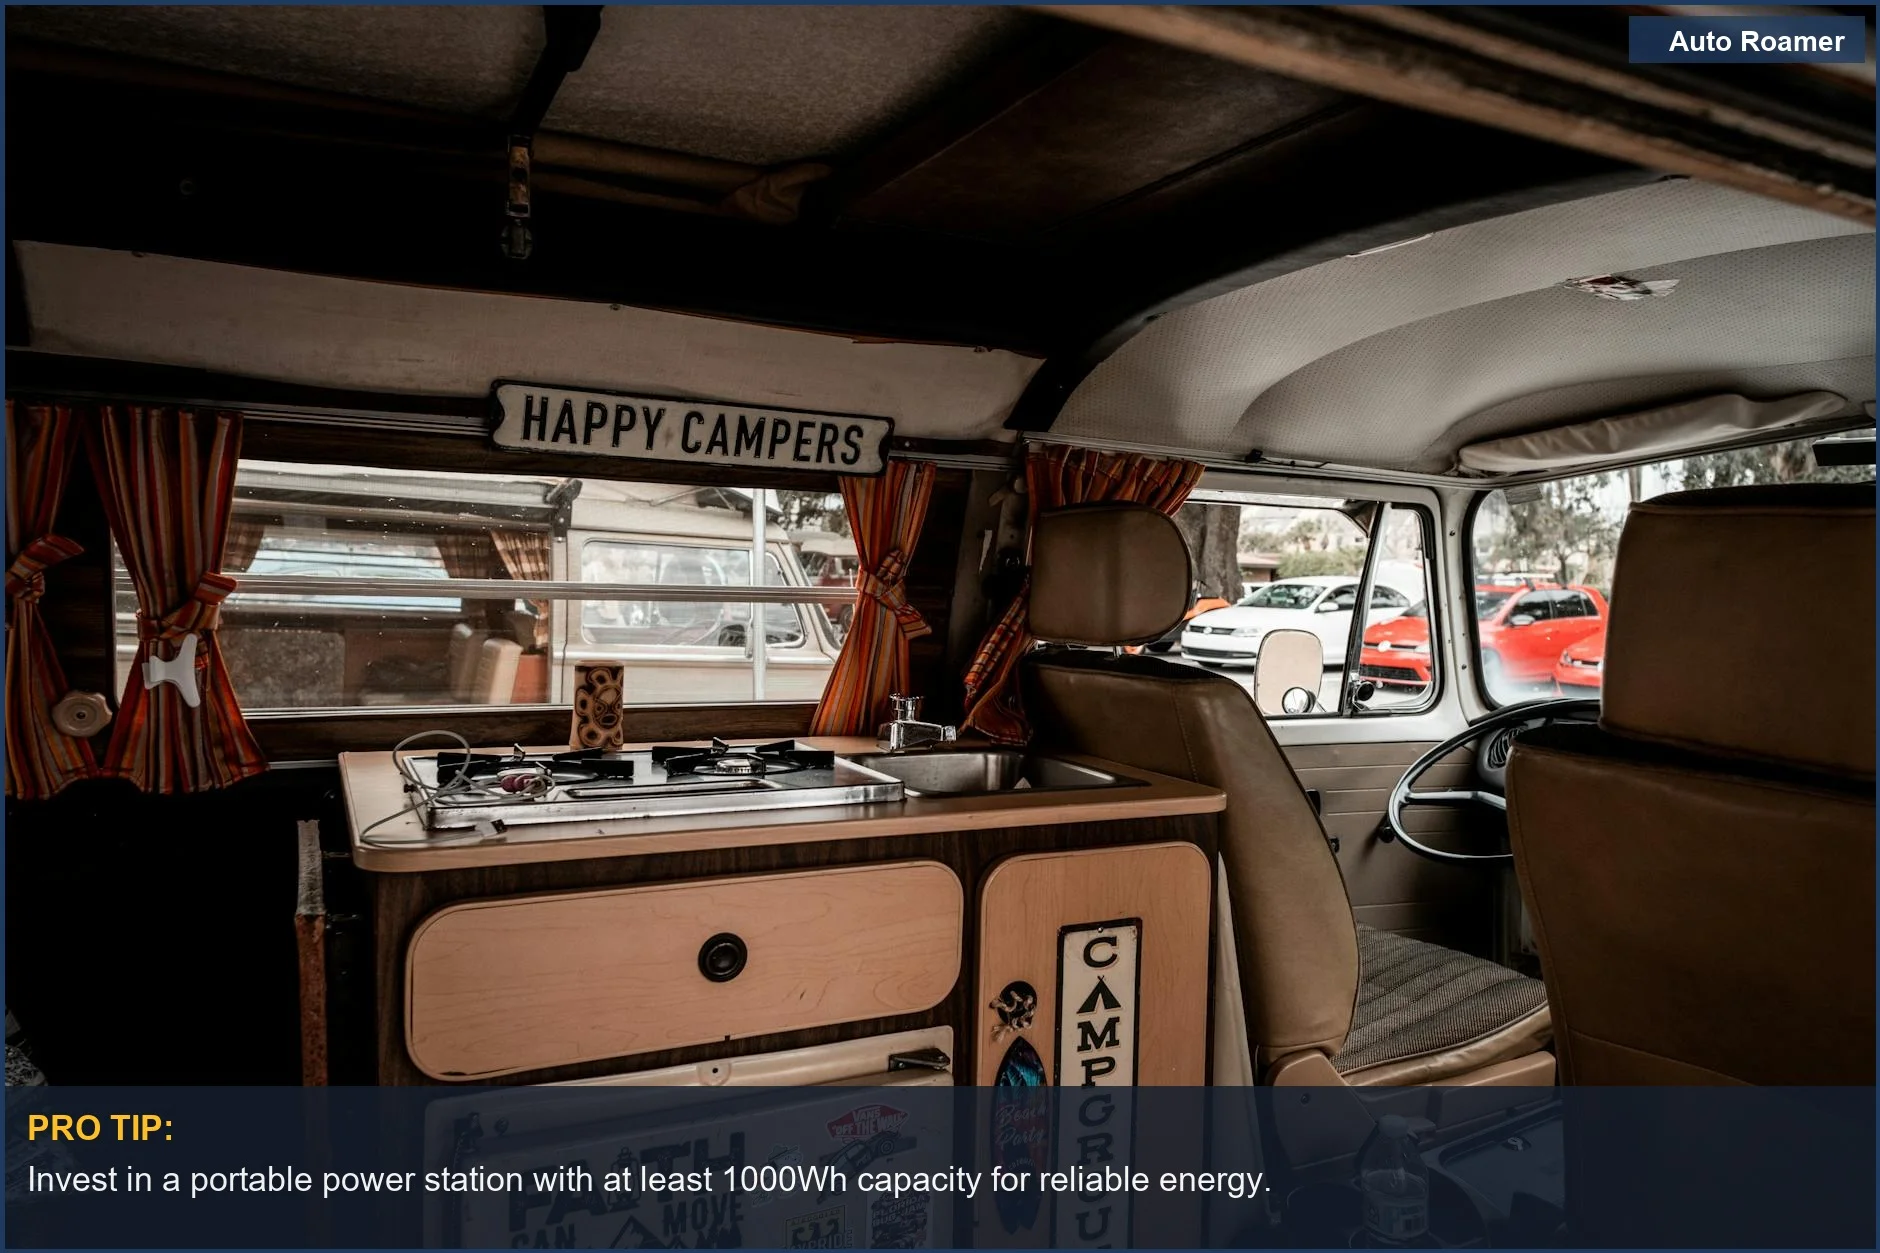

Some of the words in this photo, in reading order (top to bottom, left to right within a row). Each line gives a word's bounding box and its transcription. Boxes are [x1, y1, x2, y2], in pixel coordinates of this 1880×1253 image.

[521, 394, 666, 450] HAPPY
[681, 410, 864, 465] CAMPERS
[852, 1106, 881, 1122] VANS
[1075, 936, 1122, 1248] CAMPGROU
[855, 1118, 876, 1135] THE
[663, 1189, 744, 1236] MOVE
